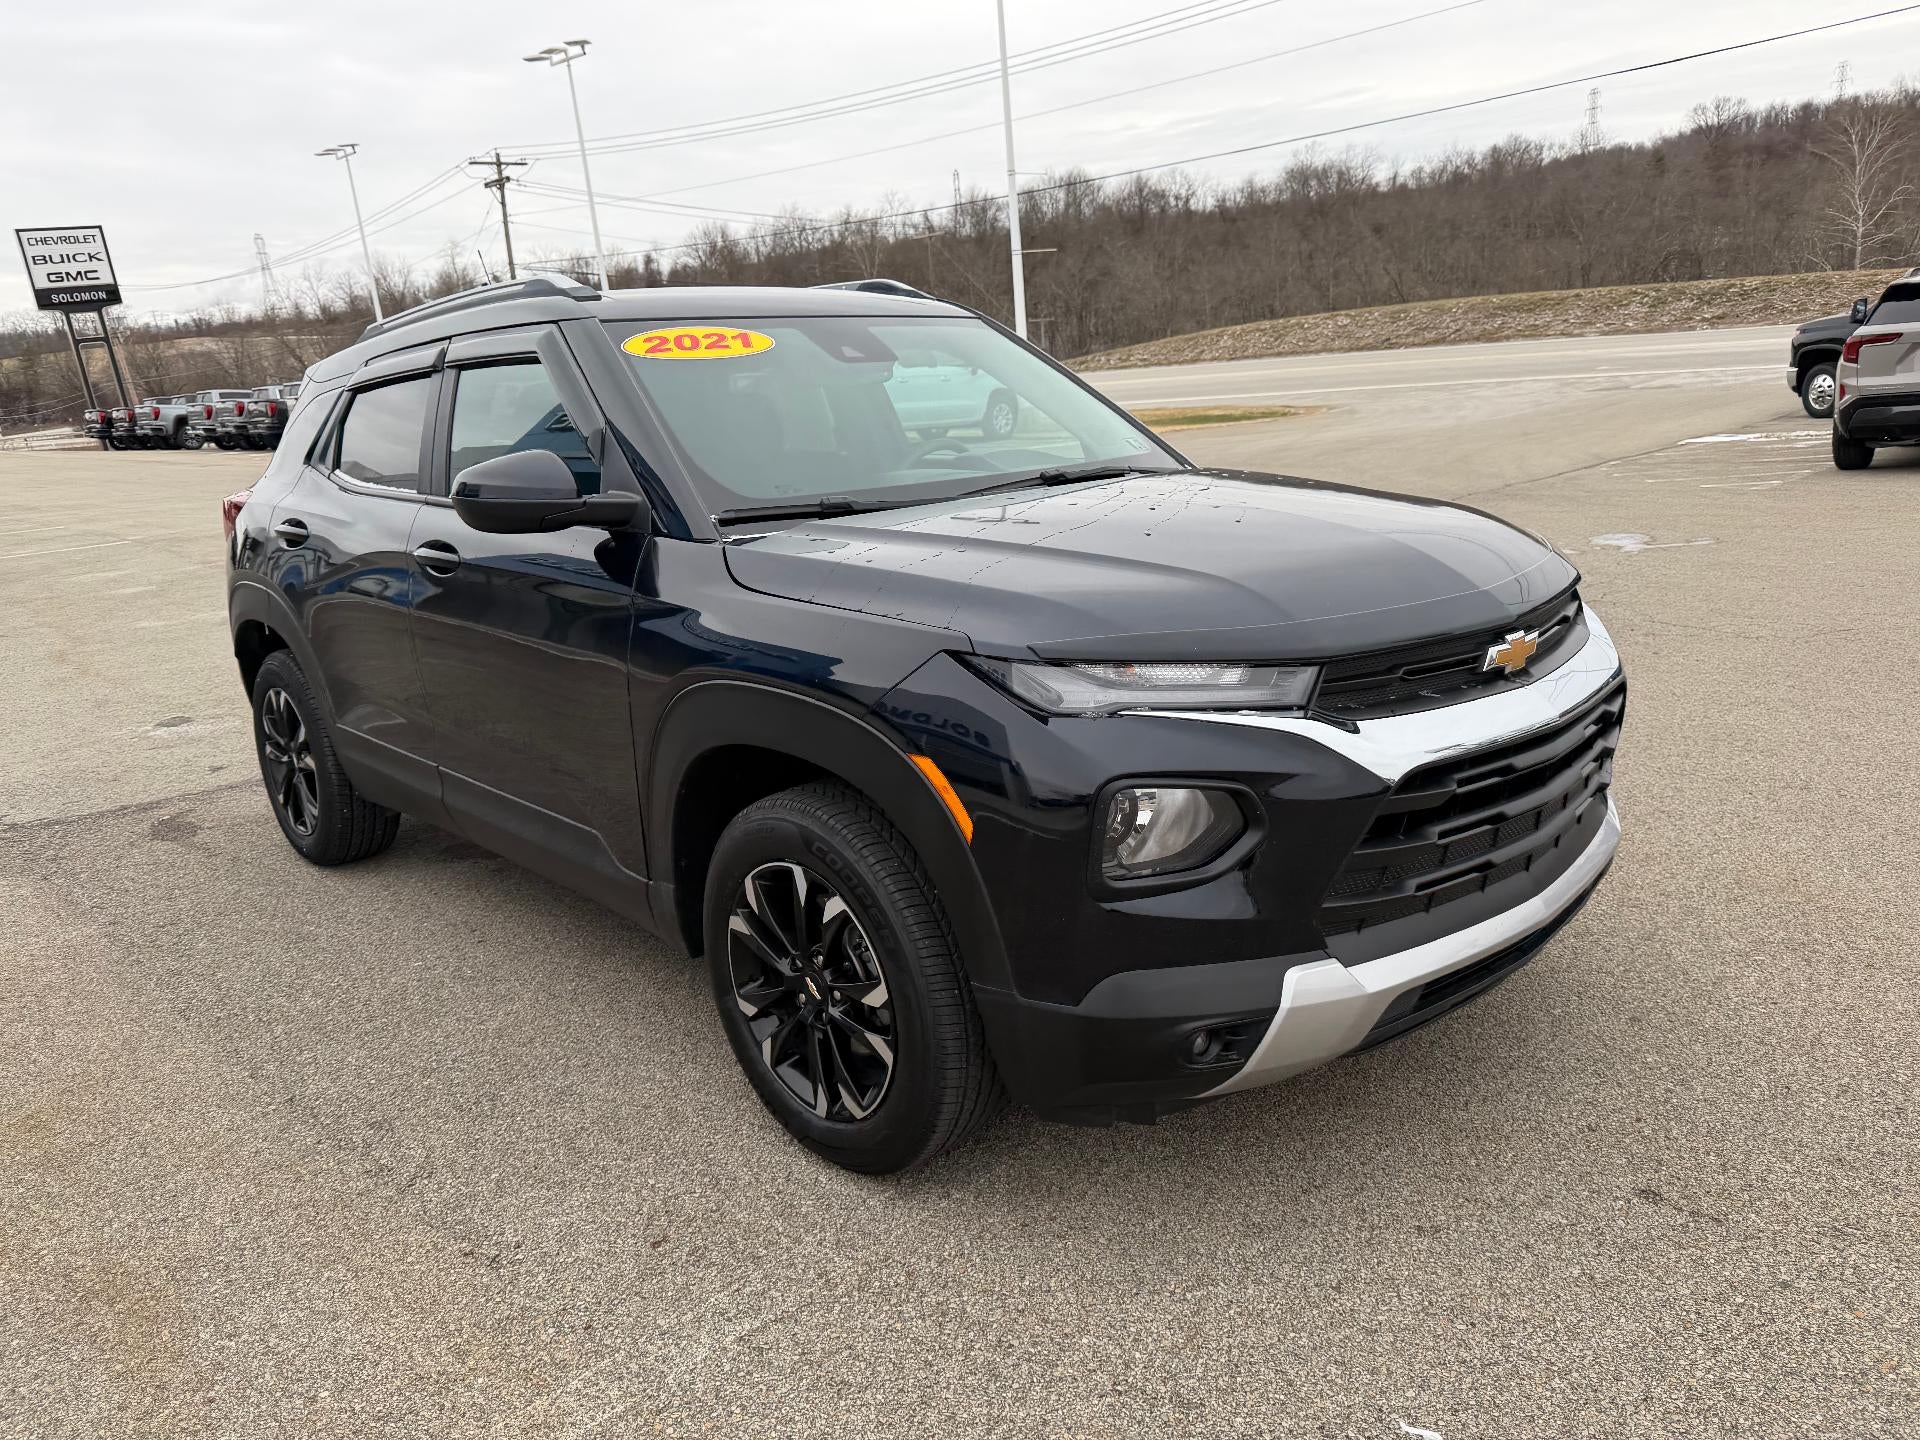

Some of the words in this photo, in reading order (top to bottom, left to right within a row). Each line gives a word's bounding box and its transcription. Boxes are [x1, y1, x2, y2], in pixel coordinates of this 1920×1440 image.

[26, 234, 97, 246] CHEVROLET
[31, 251, 104, 265] BUICK
[46, 269, 101, 283] GMC
[51, 291, 107, 303] SOLOMON
[642, 332, 753, 354] 2021
[812, 840, 897, 948] COOPER
